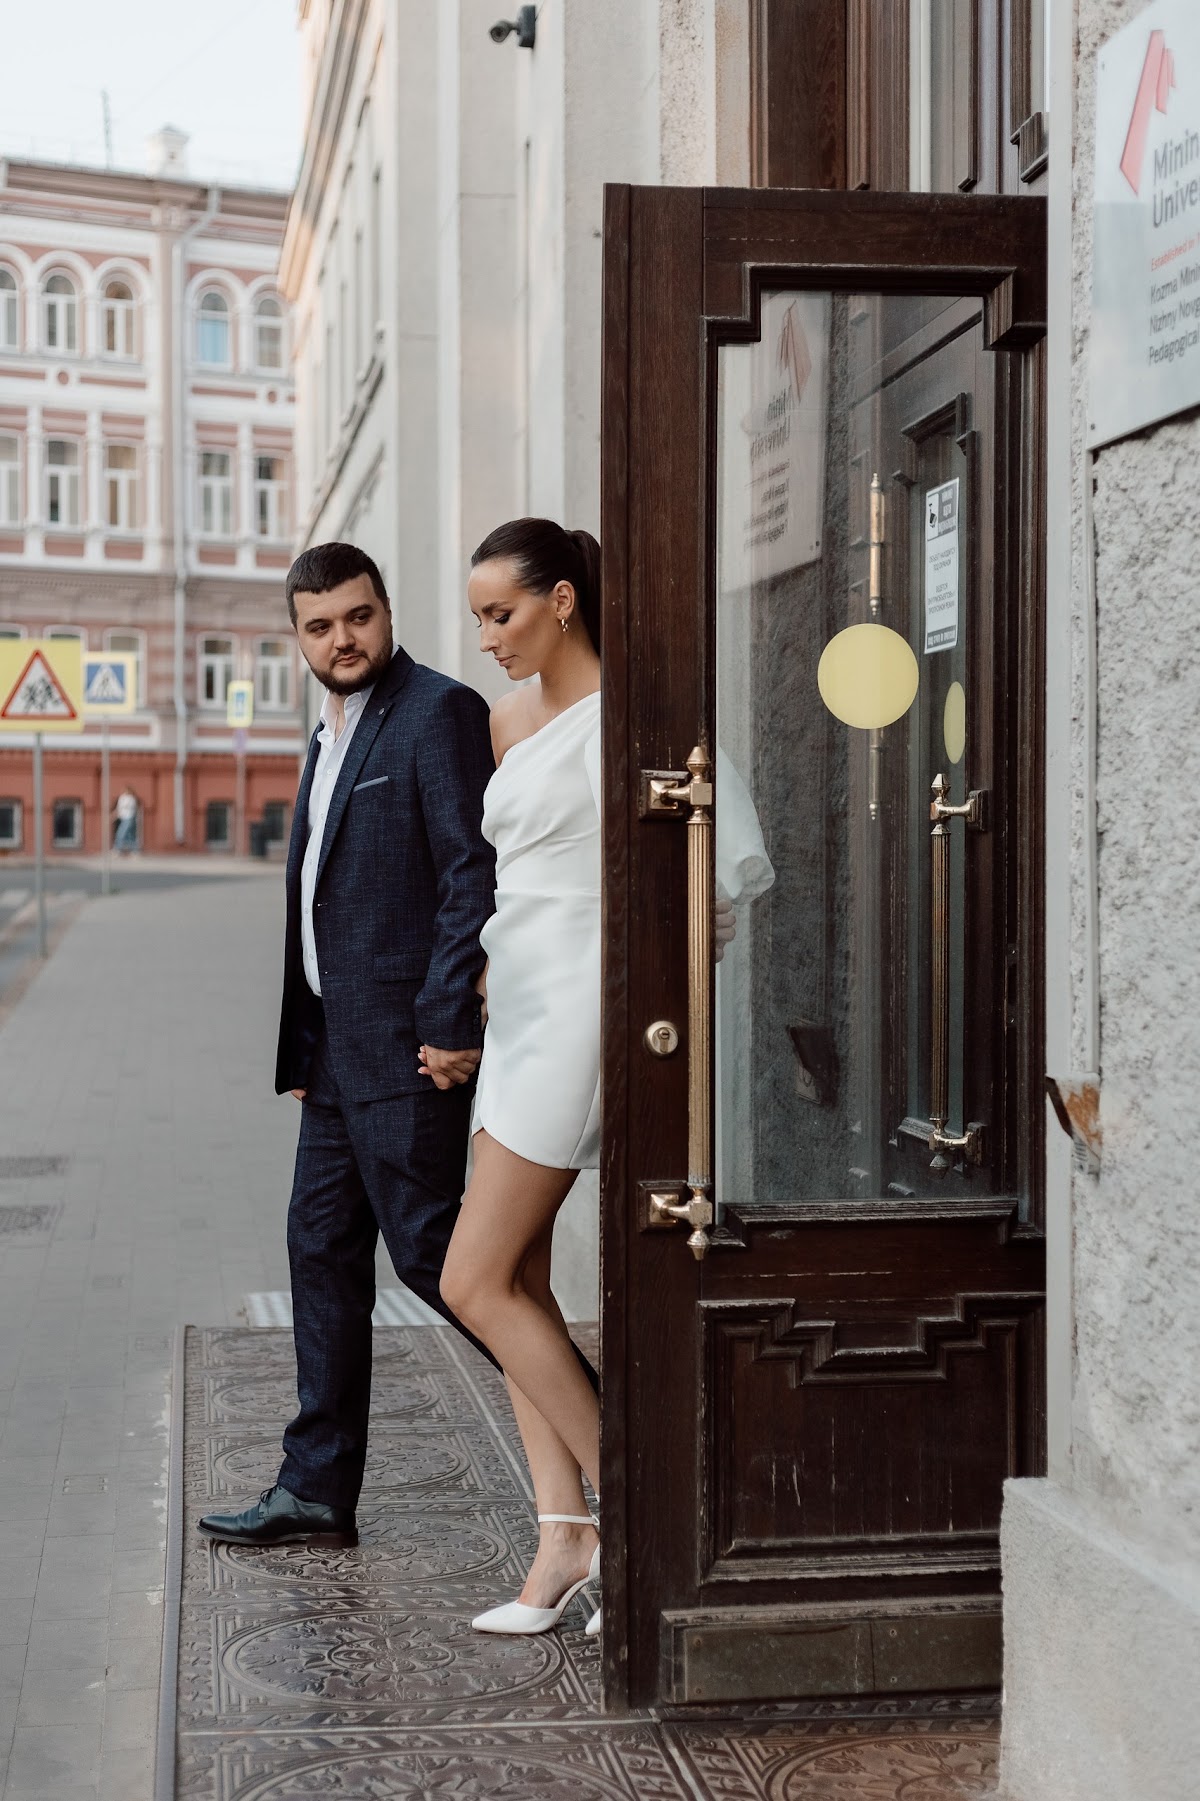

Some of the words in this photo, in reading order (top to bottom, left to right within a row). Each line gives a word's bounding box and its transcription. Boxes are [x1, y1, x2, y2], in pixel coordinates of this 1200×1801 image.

[1153, 129, 1200, 187] Minin
[1153, 178, 1200, 228] Unive
[1150, 278, 1178, 305] Kozma
[1149, 309, 1178, 336] Nizhny
